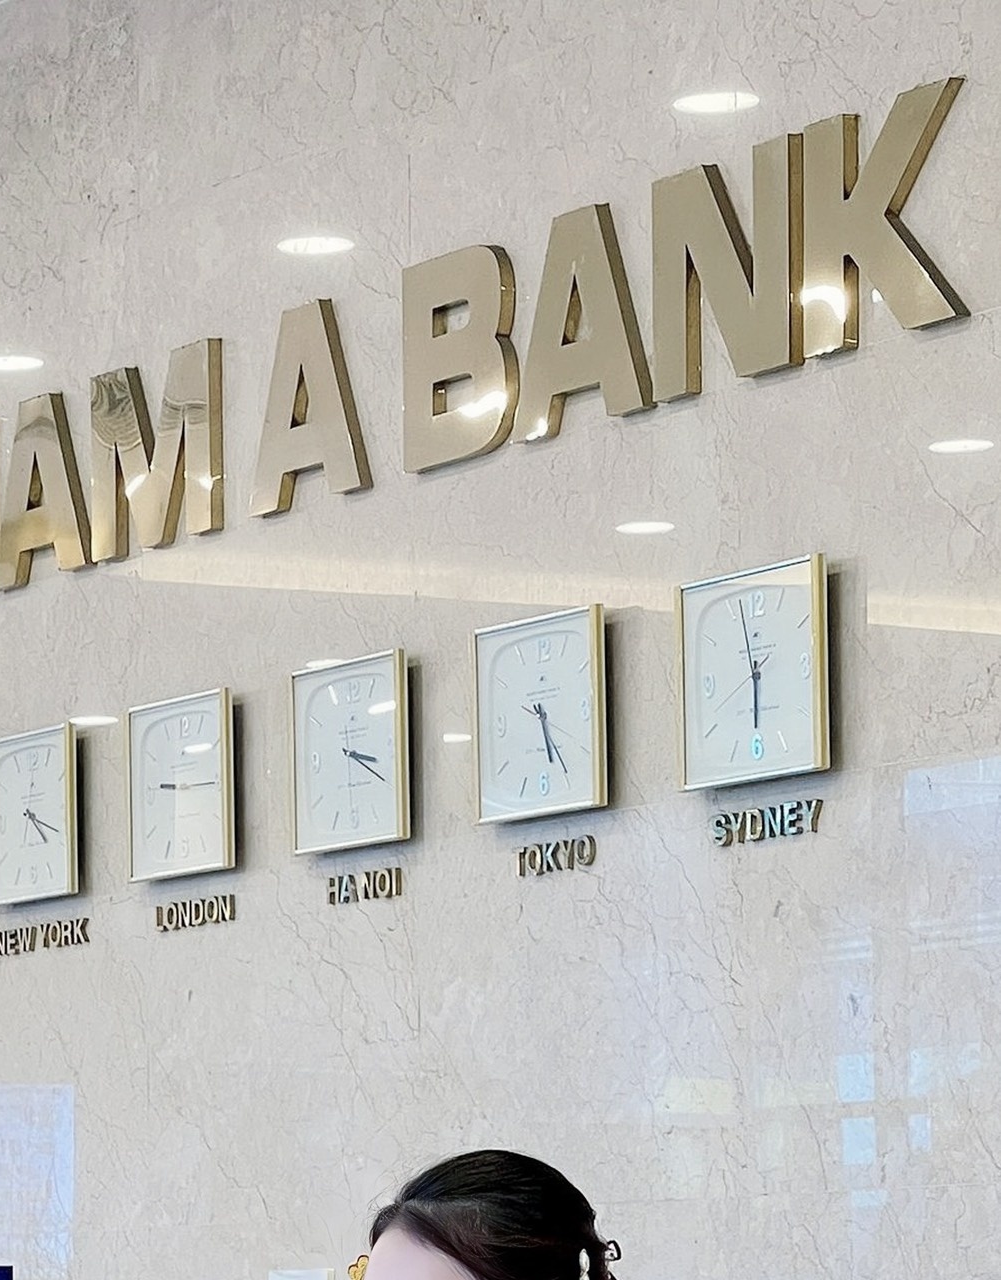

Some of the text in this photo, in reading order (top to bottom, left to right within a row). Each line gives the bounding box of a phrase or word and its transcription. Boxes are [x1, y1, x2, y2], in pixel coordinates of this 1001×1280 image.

[249, 298, 373, 518] A
[402, 74, 971, 474] BANK
[752, 734, 765, 760] 6
[711, 799, 823, 846] SYDNEY
[515, 834, 597, 878] TOKYO
[326, 867, 403, 905] HANOI
[155, 894, 236, 932] LONDON
[39, 917, 90, 948] YORK
